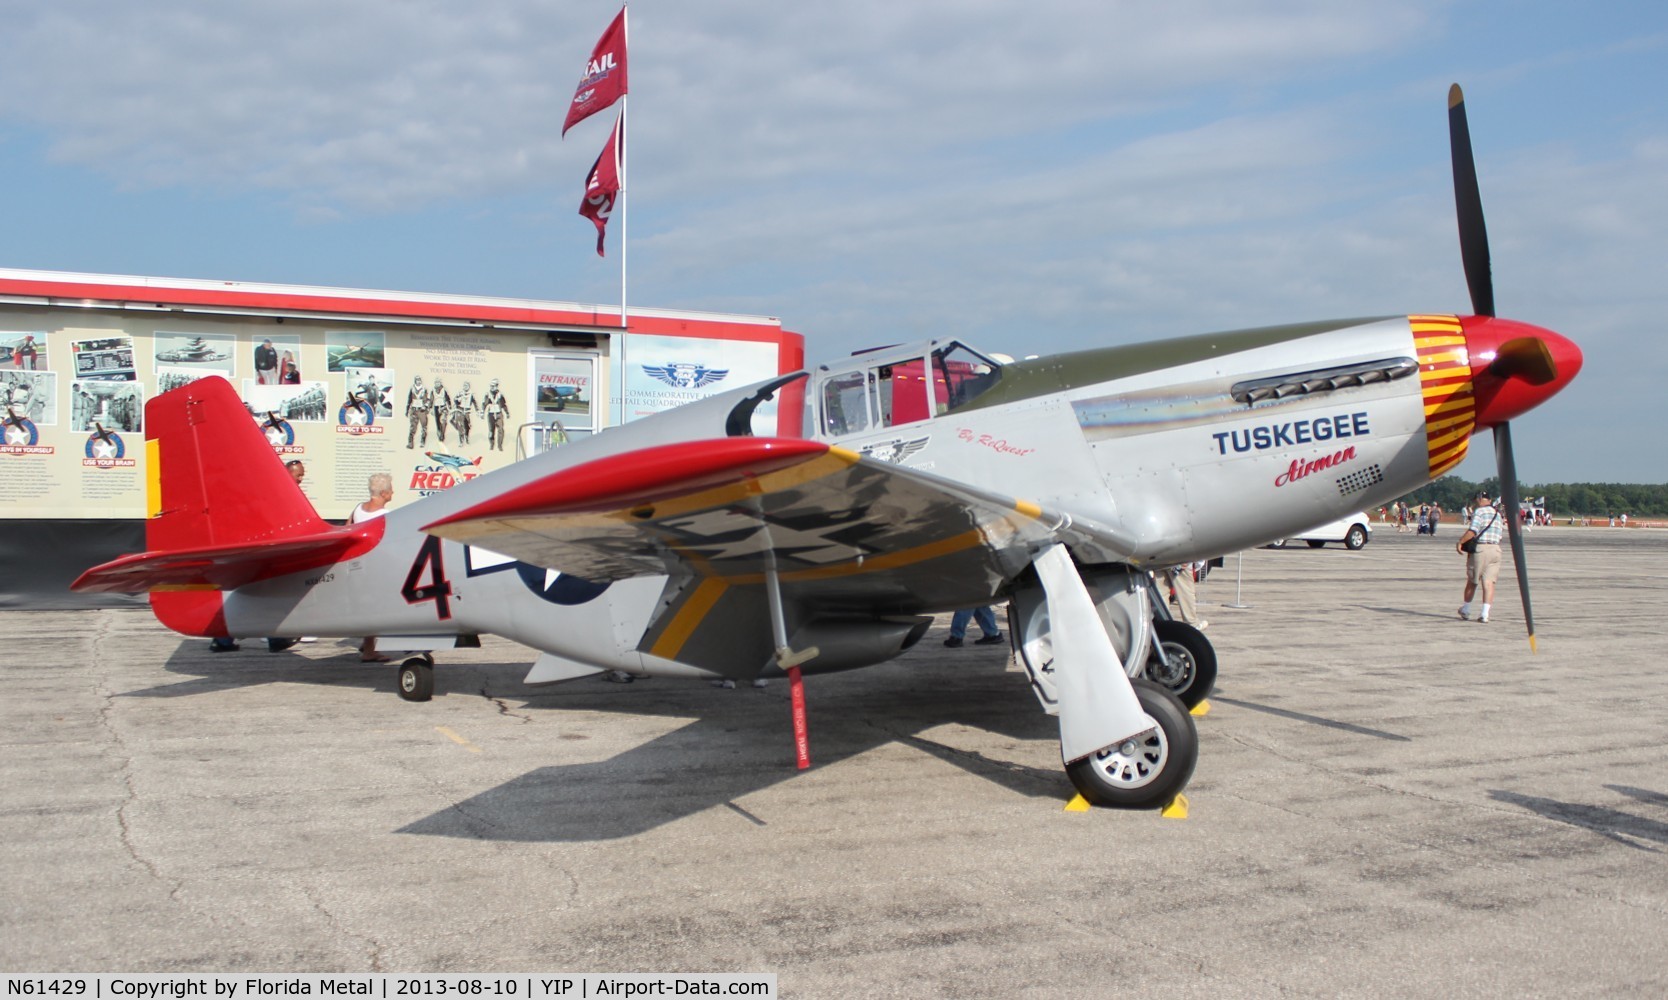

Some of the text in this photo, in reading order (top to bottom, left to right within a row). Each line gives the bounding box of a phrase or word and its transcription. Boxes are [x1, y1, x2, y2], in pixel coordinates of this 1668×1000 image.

[540, 375, 587, 386] ENTRANCE
[625, 389, 699, 400] COMMEMORATIVE
[1212, 411, 1370, 455] TUSKEGEE
[23, 447, 53, 455] YOURSELF
[1274, 445, 1357, 487] Airmen
[410, 472, 455, 489] RED
[400, 533, 453, 621] 4
